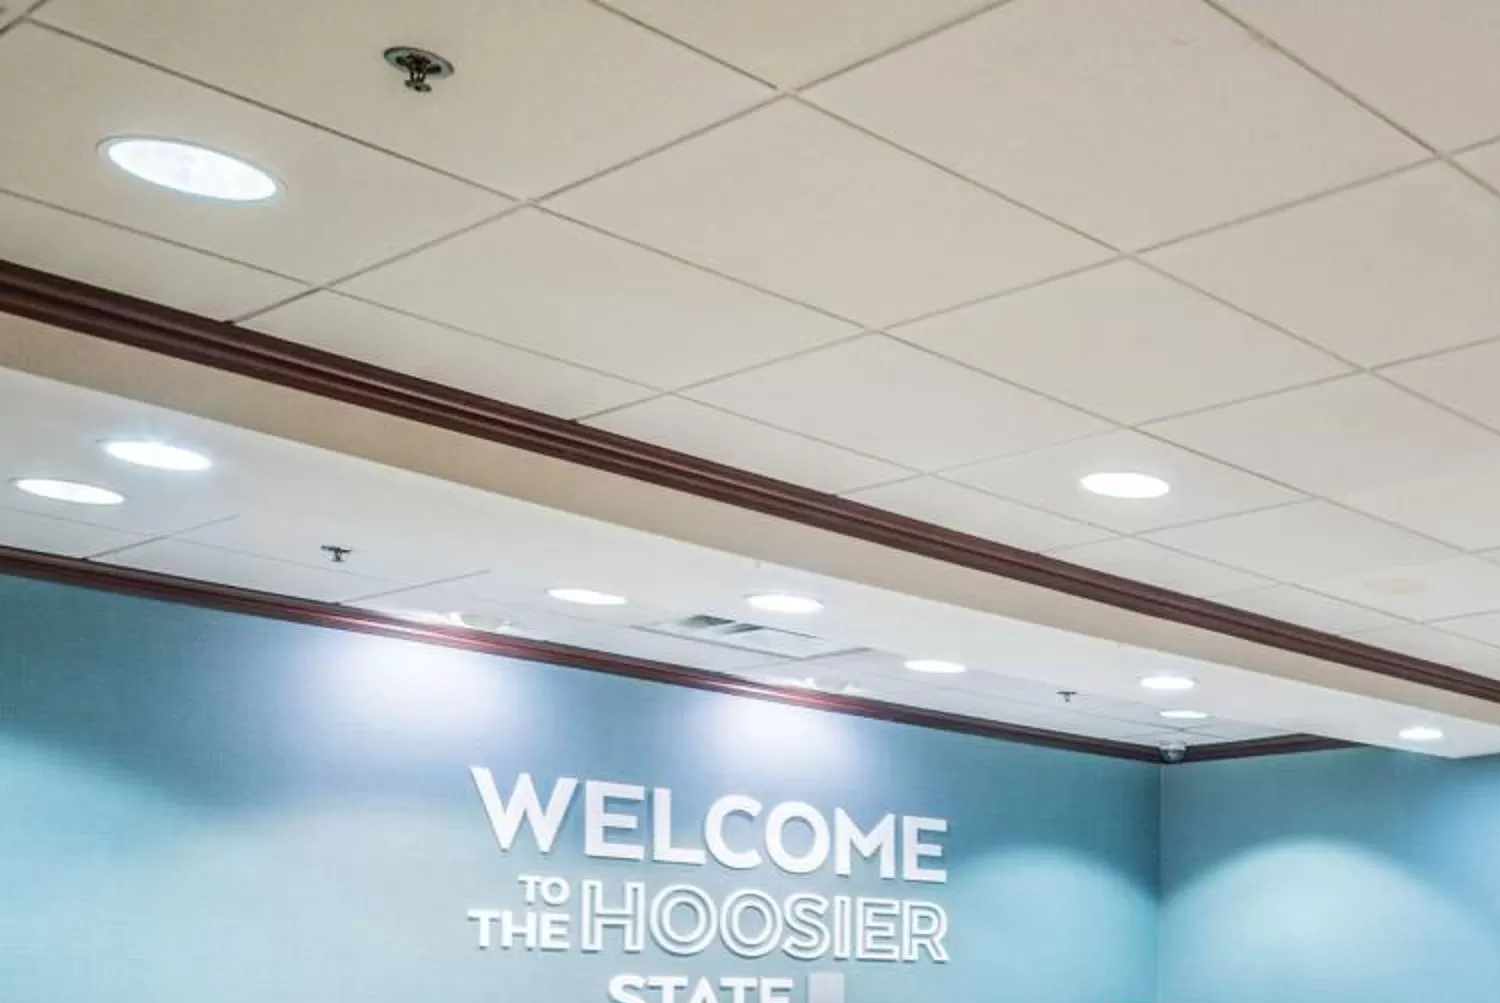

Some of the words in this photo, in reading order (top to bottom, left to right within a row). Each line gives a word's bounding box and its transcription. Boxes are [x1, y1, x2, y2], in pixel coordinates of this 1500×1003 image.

[470, 767, 948, 883] WELCOME
[467, 909, 571, 950] THE
[581, 880, 950, 962] HOOSIER
[517, 874, 571, 905] TO
